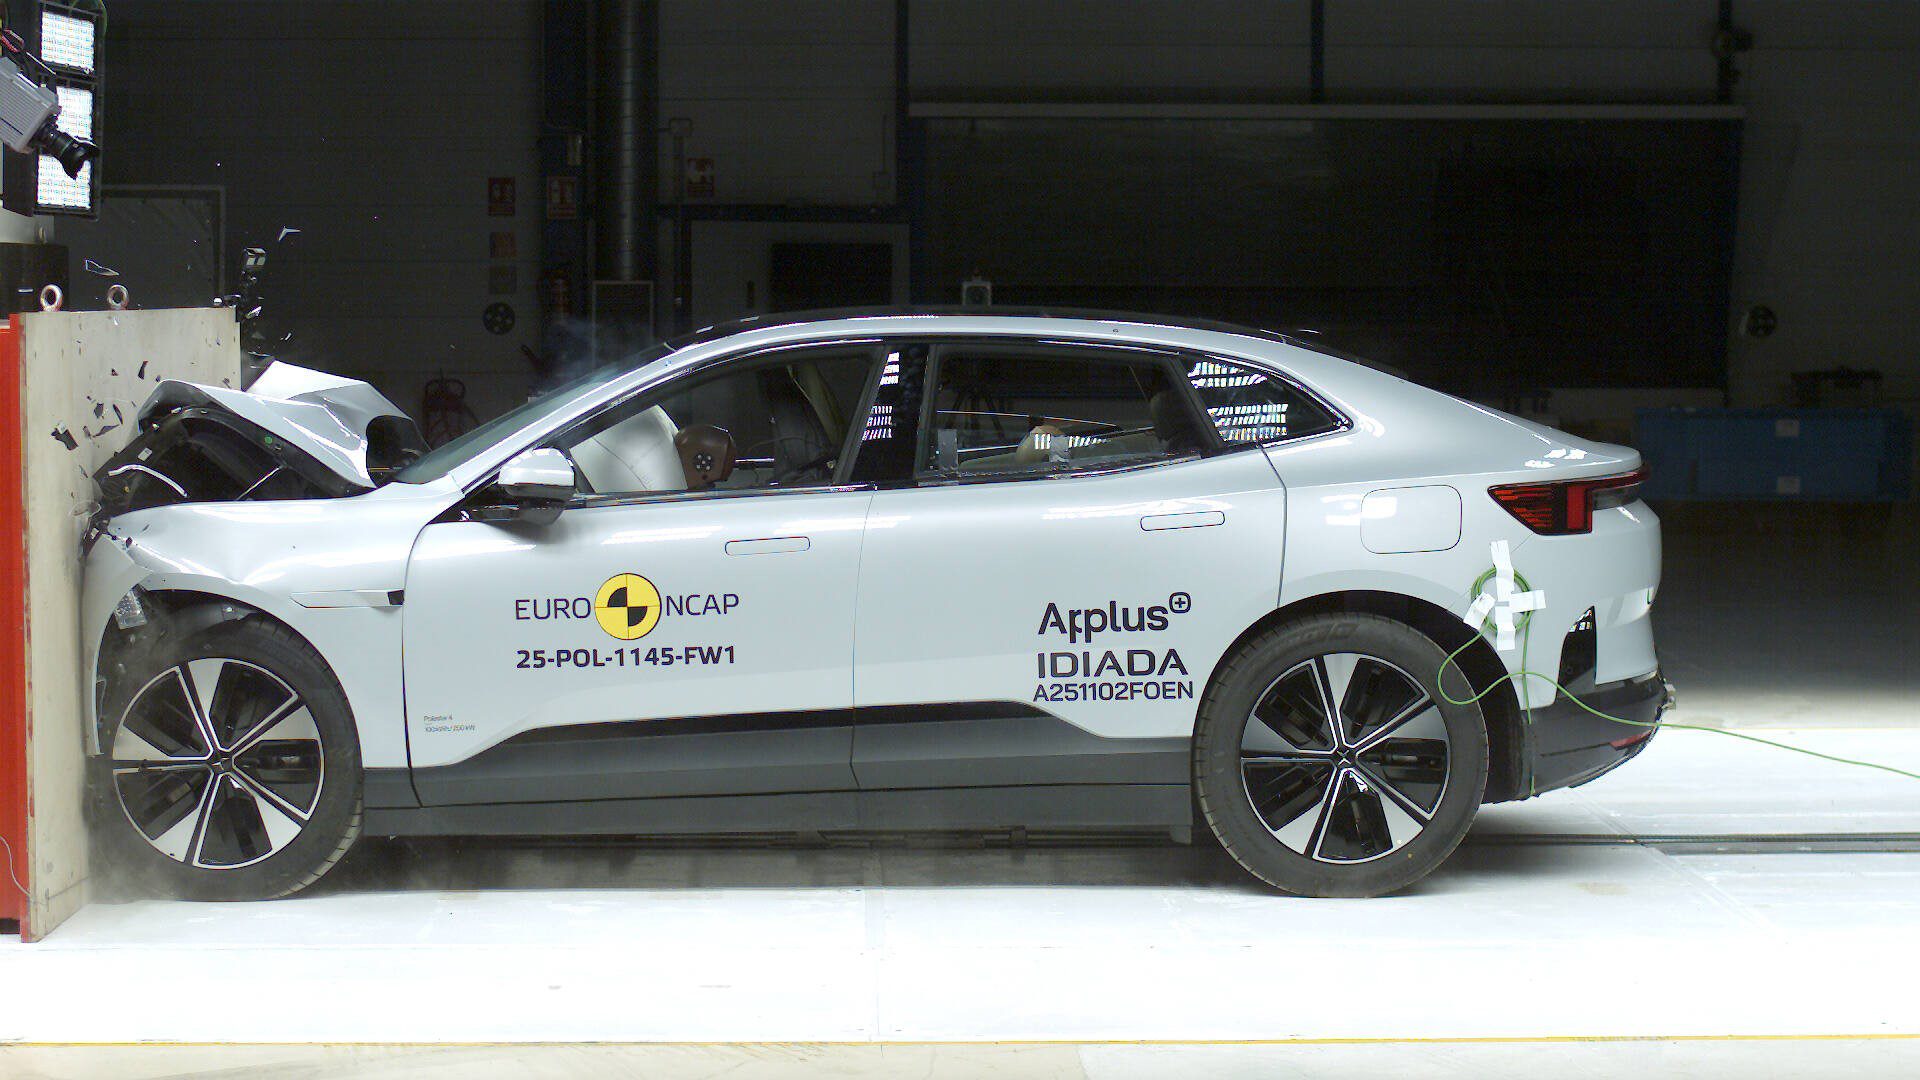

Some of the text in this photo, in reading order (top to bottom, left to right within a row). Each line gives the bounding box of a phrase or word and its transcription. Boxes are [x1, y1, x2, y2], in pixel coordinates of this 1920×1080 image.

[515, 593, 740, 620] EURO NCAP
[516, 645, 735, 669] 25-POL-1145-FW1
[1037, 648, 1188, 679] IDIADA
